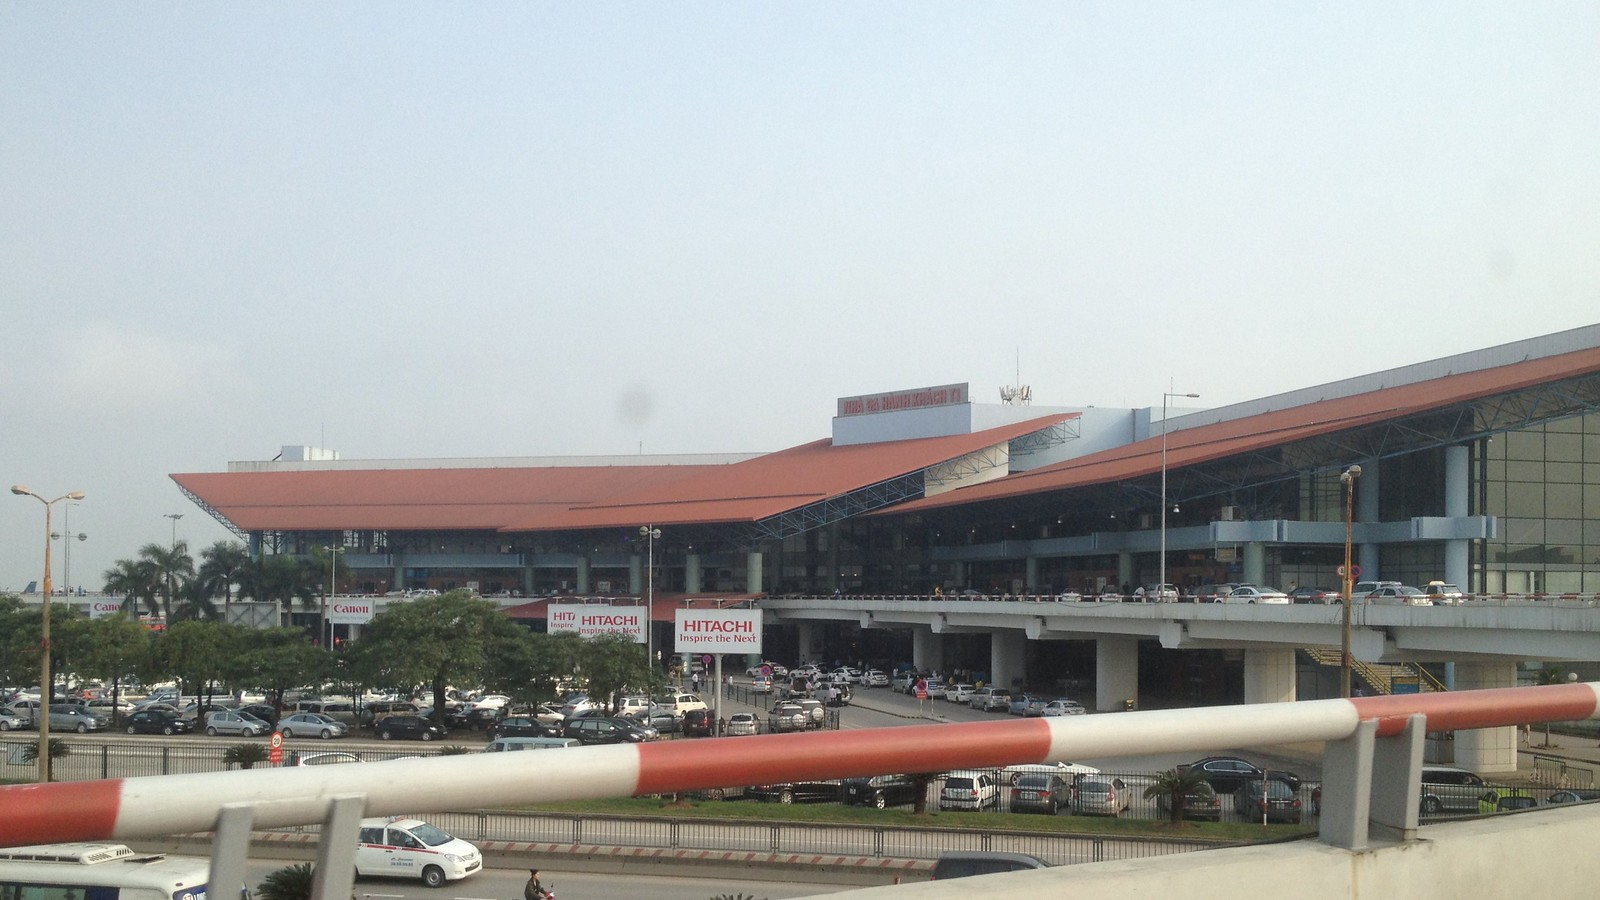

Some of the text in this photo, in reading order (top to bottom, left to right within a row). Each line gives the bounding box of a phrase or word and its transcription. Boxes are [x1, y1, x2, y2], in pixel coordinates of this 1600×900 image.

[94, 602, 121, 612] Cano
[333, 604, 369, 613] Canon
[581, 615, 638, 626] HITACHI
[578, 627, 605, 635] Inspire
[622, 626, 641, 634] Next
[684, 620, 752, 632] HITACHI
[680, 633, 757, 643] Inspire the Next
[273, 737, 281, 745] 20
